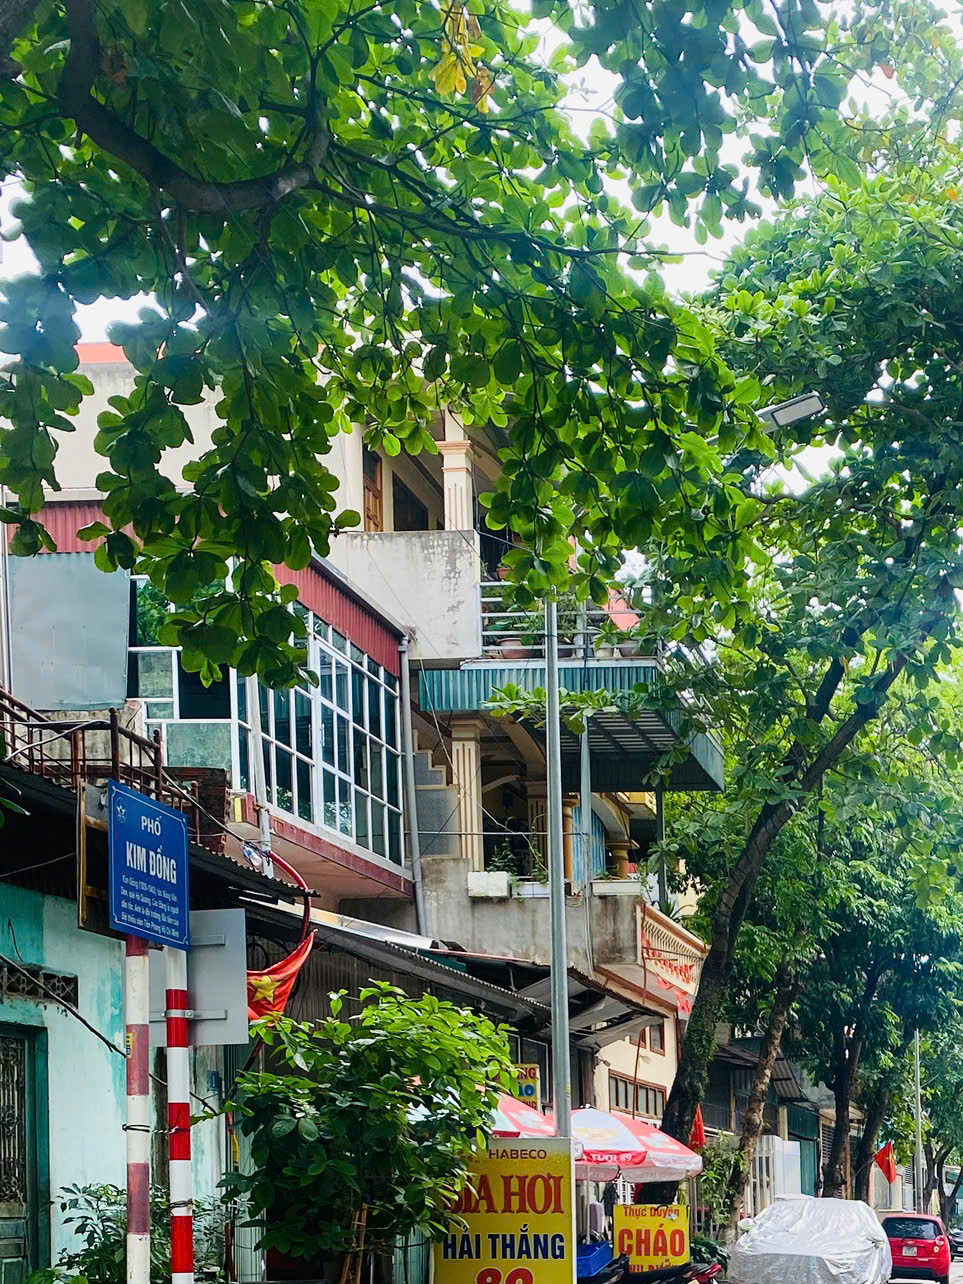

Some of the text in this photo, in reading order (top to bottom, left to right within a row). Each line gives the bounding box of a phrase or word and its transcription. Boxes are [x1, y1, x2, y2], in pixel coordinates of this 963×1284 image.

[141, 815, 162, 836] PHỐ
[125, 841, 147, 873] KIM
[489, 1149, 547, 1160] HABECO
[621, 1153, 632, 1162] 89
[501, 1171, 564, 1215] HƠI
[443, 1224, 565, 1259] HẢI THẮNG
[618, 1223, 685, 1257] CHÁO
